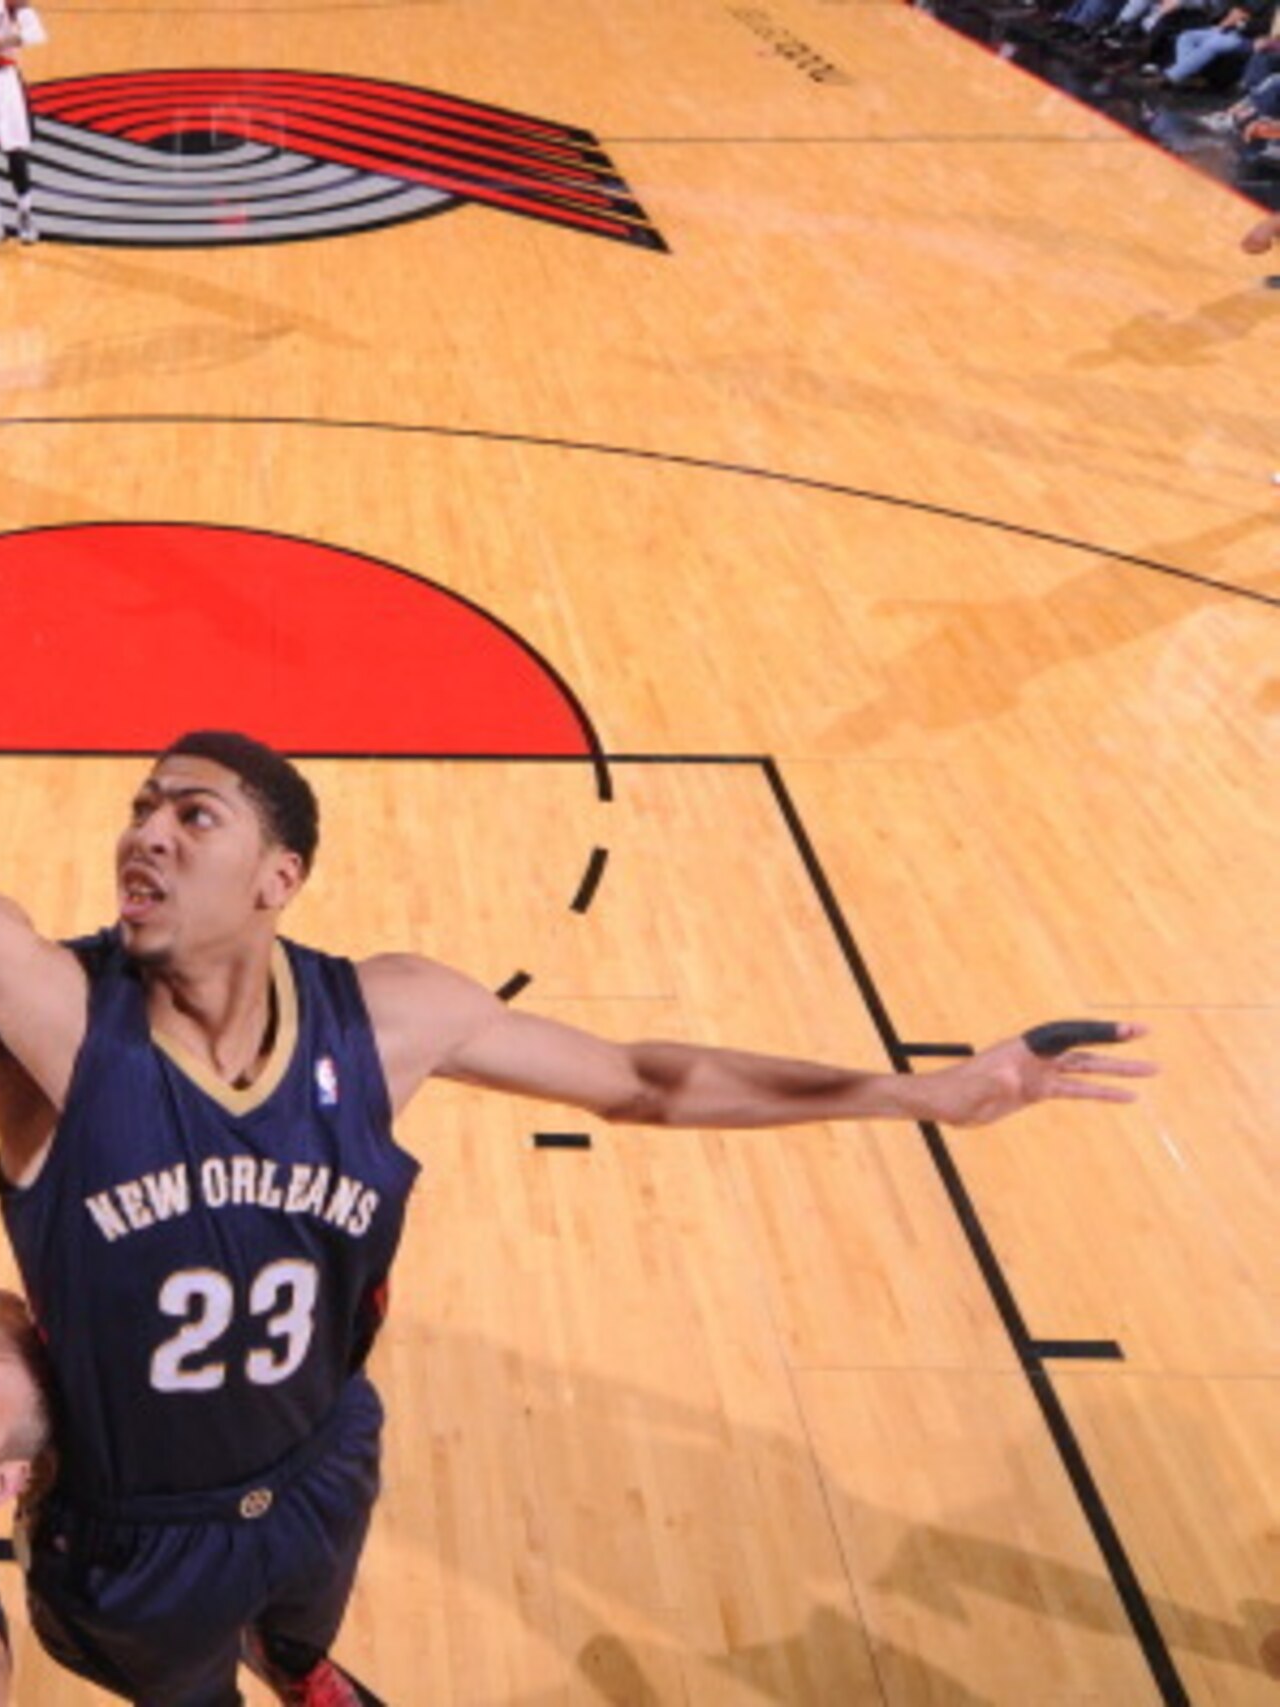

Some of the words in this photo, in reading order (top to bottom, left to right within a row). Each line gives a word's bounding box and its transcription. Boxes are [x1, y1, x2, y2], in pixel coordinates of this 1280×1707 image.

[85, 1162, 190, 1242] NEW
[201, 1155, 380, 1237] ORLEANS
[150, 1257, 320, 1393] 23
